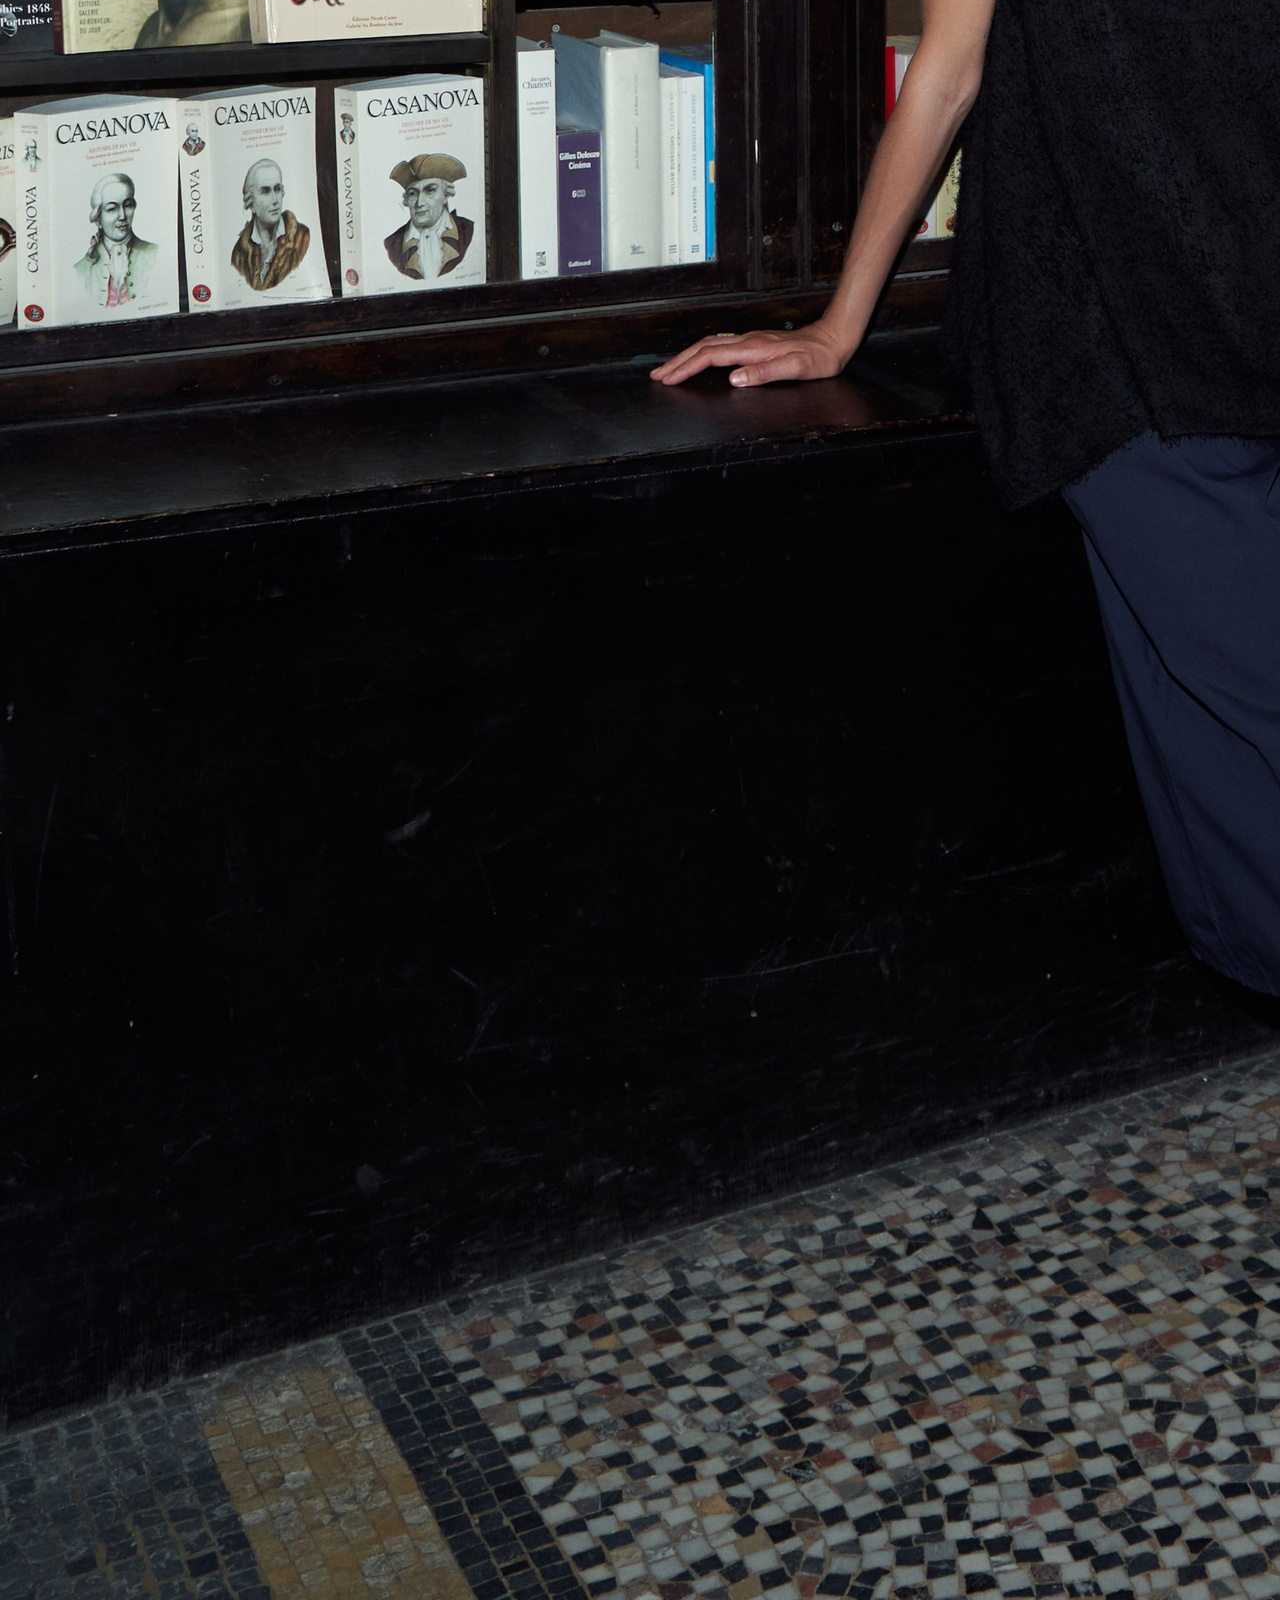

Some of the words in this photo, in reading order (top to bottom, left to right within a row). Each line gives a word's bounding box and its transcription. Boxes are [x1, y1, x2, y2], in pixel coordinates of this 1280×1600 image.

[522, 80, 552, 90] Chancel
[214, 96, 312, 127] CASANOVA
[366, 88, 481, 119] CASANOVA
[56, 111, 171, 145] CASANOVA
[559, 153, 576, 161] Gilles
[577, 151, 600, 160] Deleuze
[568, 161, 592, 170] Cinéma
[190, 168, 204, 254] CASANOVA
[344, 157, 355, 241] CASANOVA
[25, 185, 39, 274] CASANOVA
